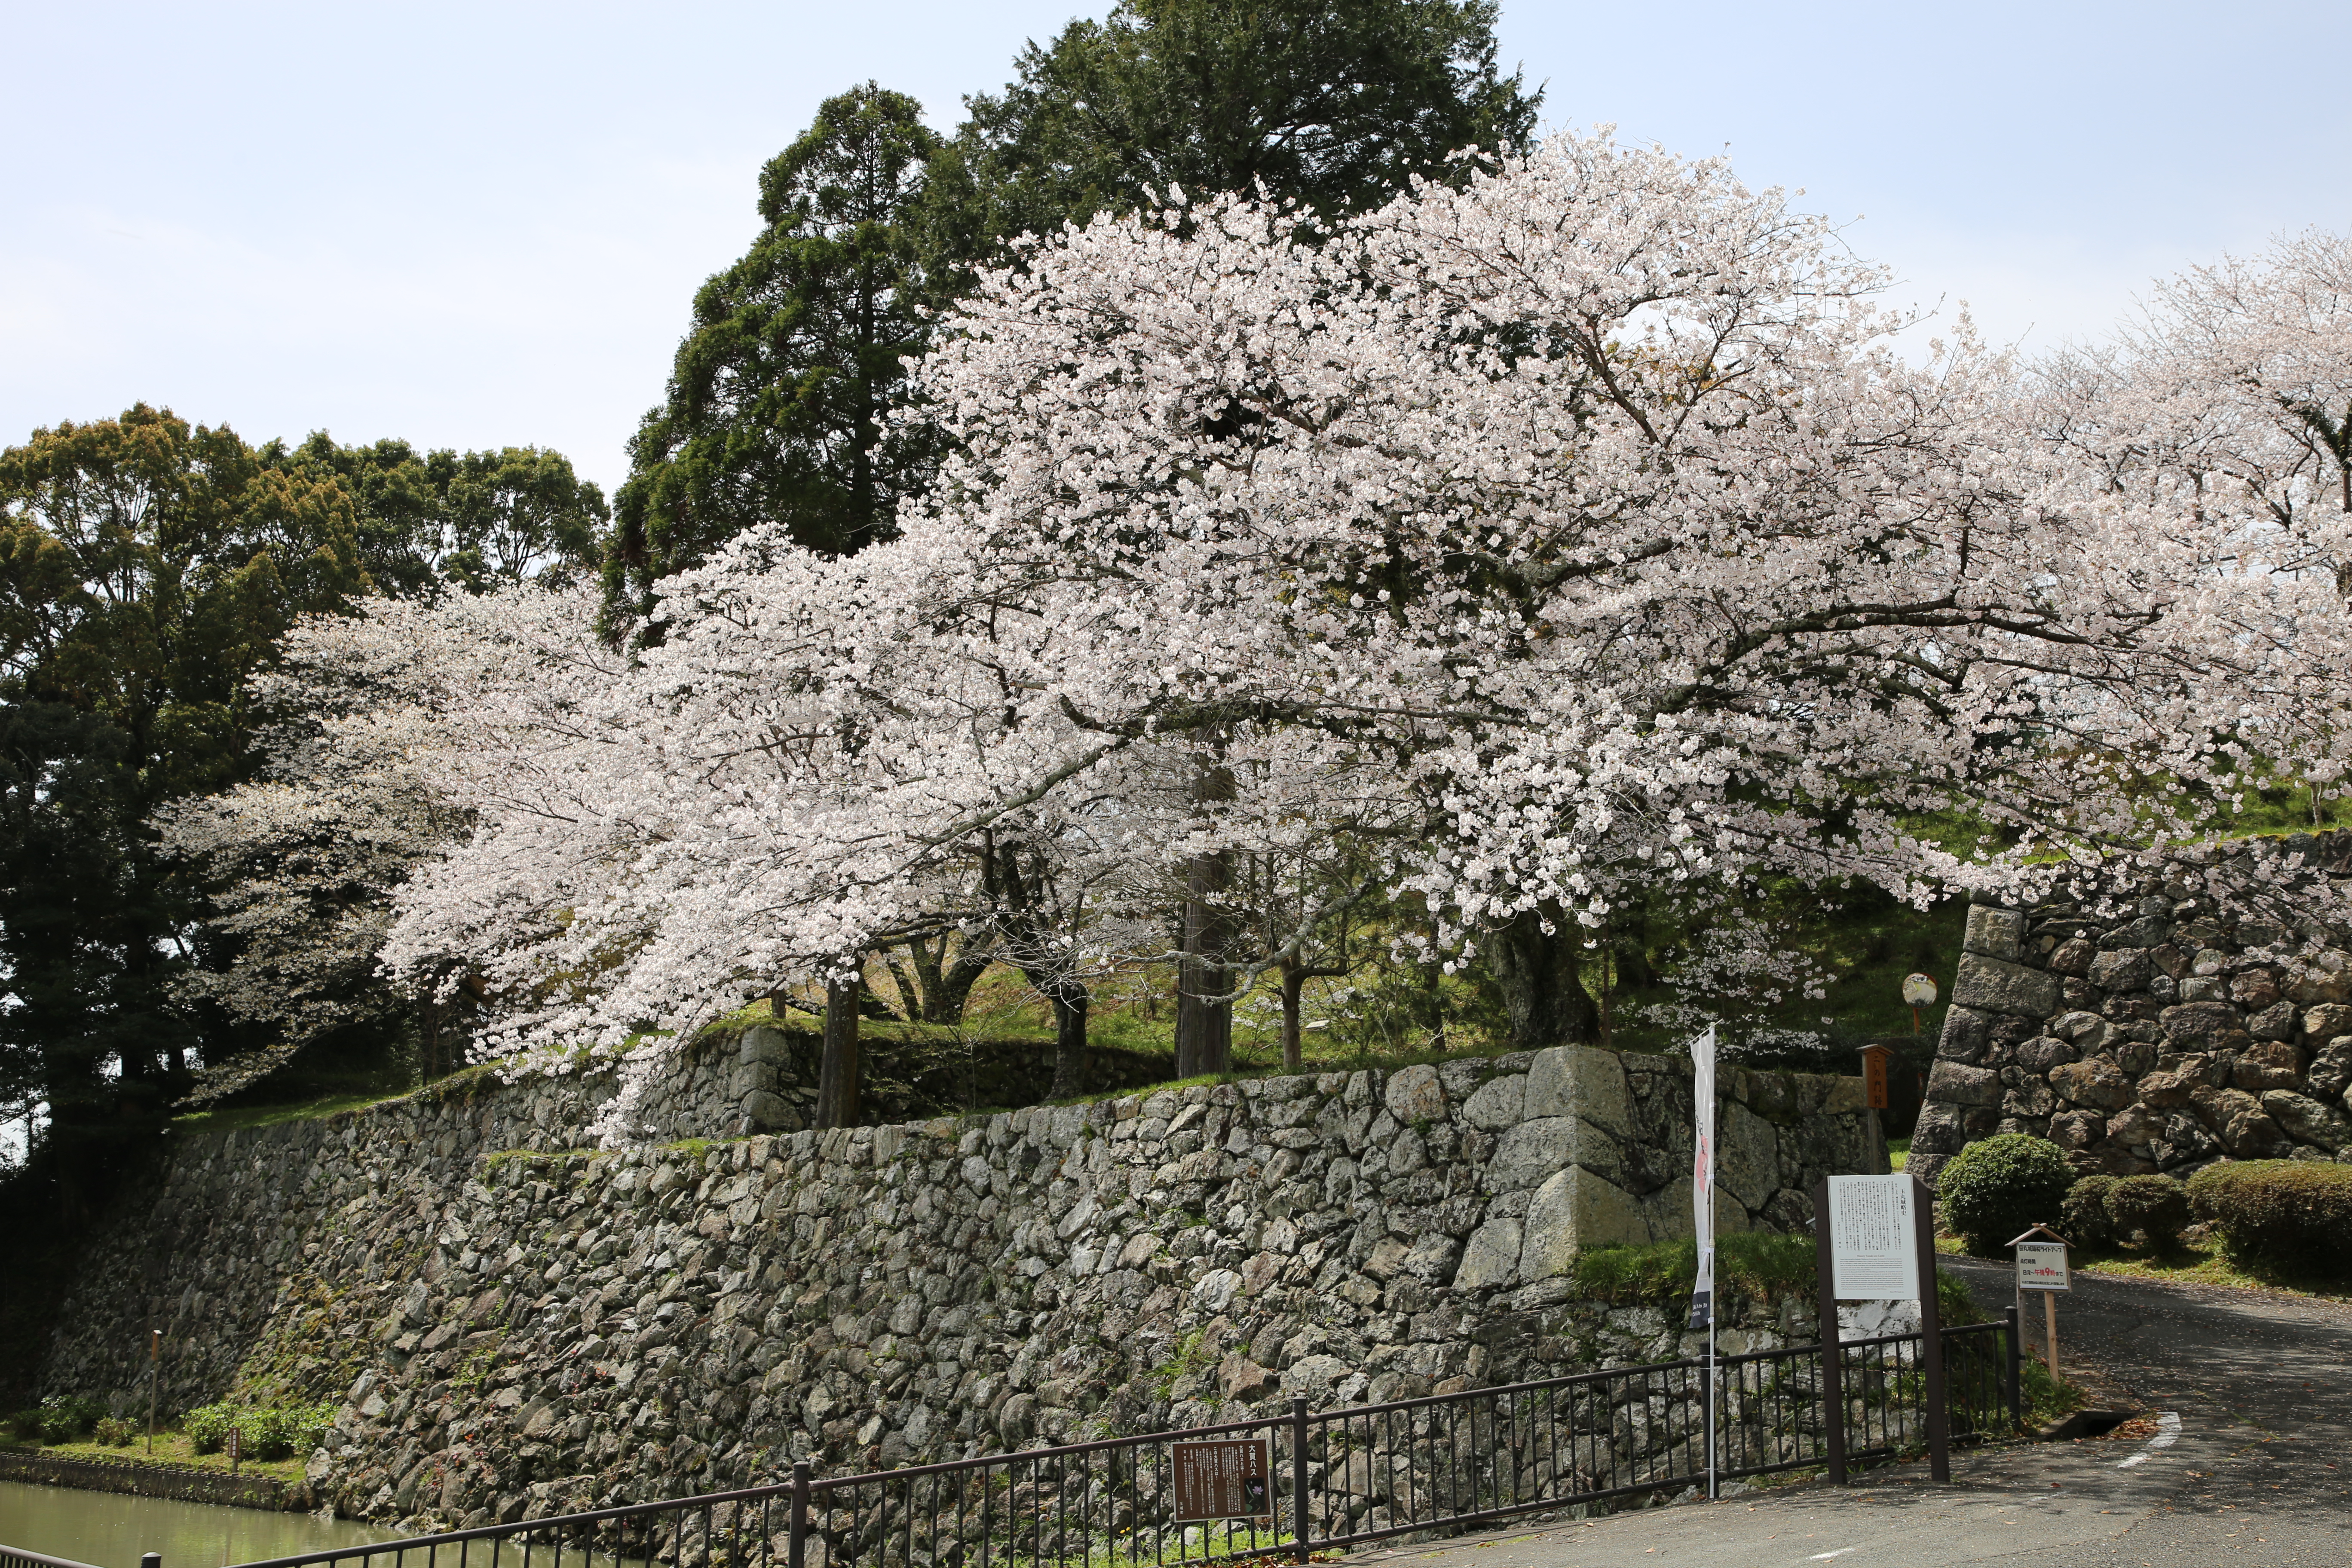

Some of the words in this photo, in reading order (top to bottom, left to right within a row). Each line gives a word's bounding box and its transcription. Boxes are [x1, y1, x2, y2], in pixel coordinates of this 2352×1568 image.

[1874, 1056, 1882, 1106] 二の門跡
[1249, 1444, 1257, 1476] 大賀ハス
